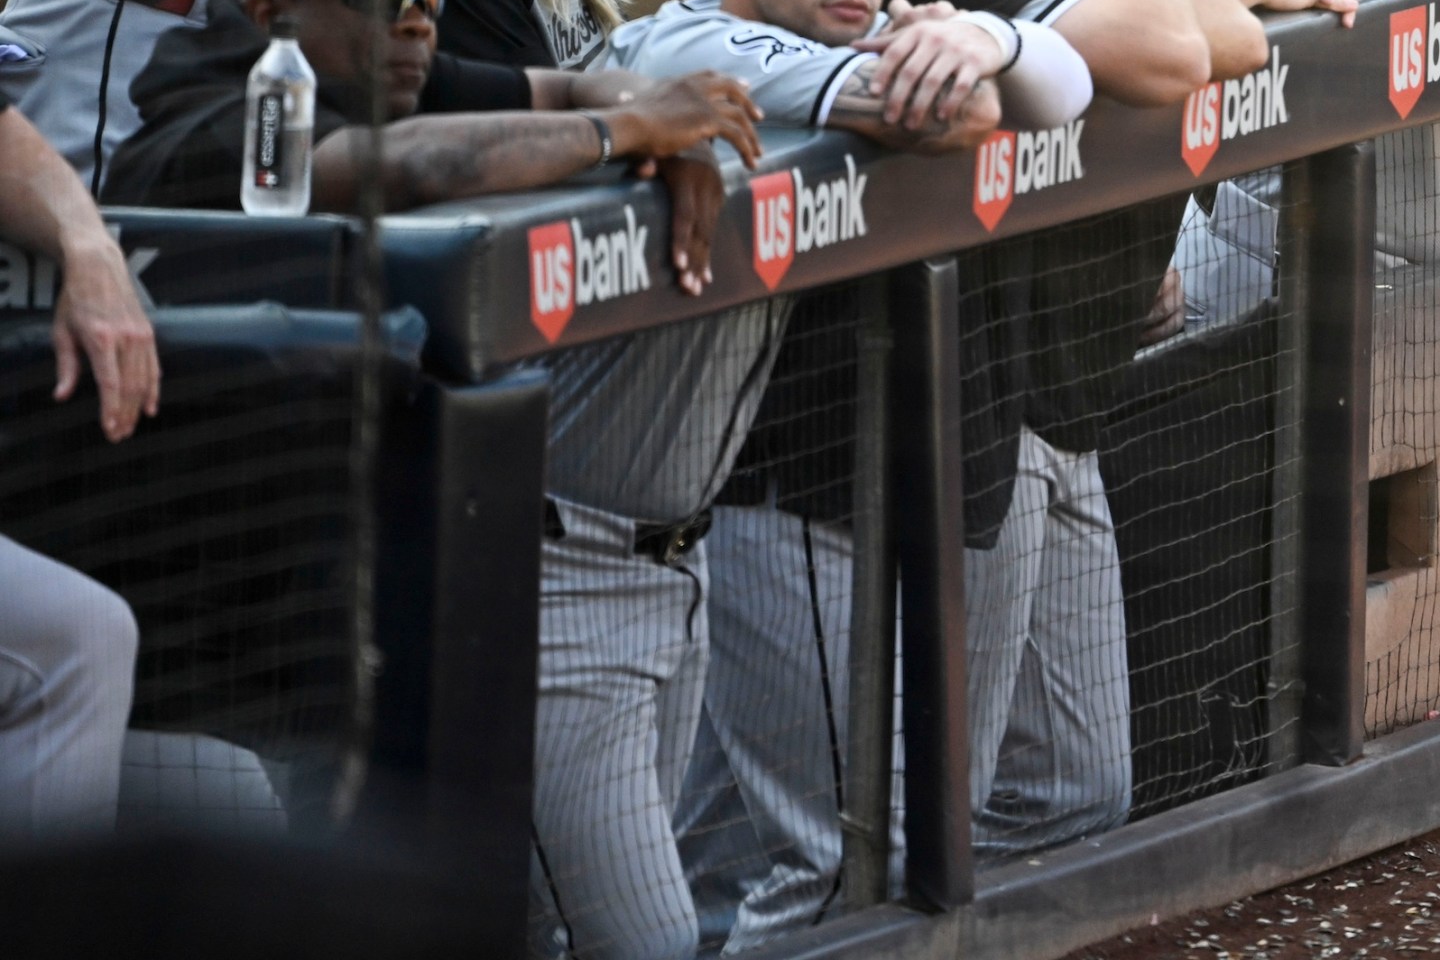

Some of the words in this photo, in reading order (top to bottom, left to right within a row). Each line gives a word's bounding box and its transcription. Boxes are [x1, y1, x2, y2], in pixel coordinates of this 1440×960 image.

[1186, 81, 1219, 151] us
[1221, 44, 1290, 140] bank
[1392, 27, 1423, 92] us
[755, 193, 792, 262] us
[792, 152, 868, 254] bank
[977, 136, 1013, 204] us
[1014, 119, 1085, 194] bank
[532, 243, 573, 315] us
[572, 203, 651, 306] bank
